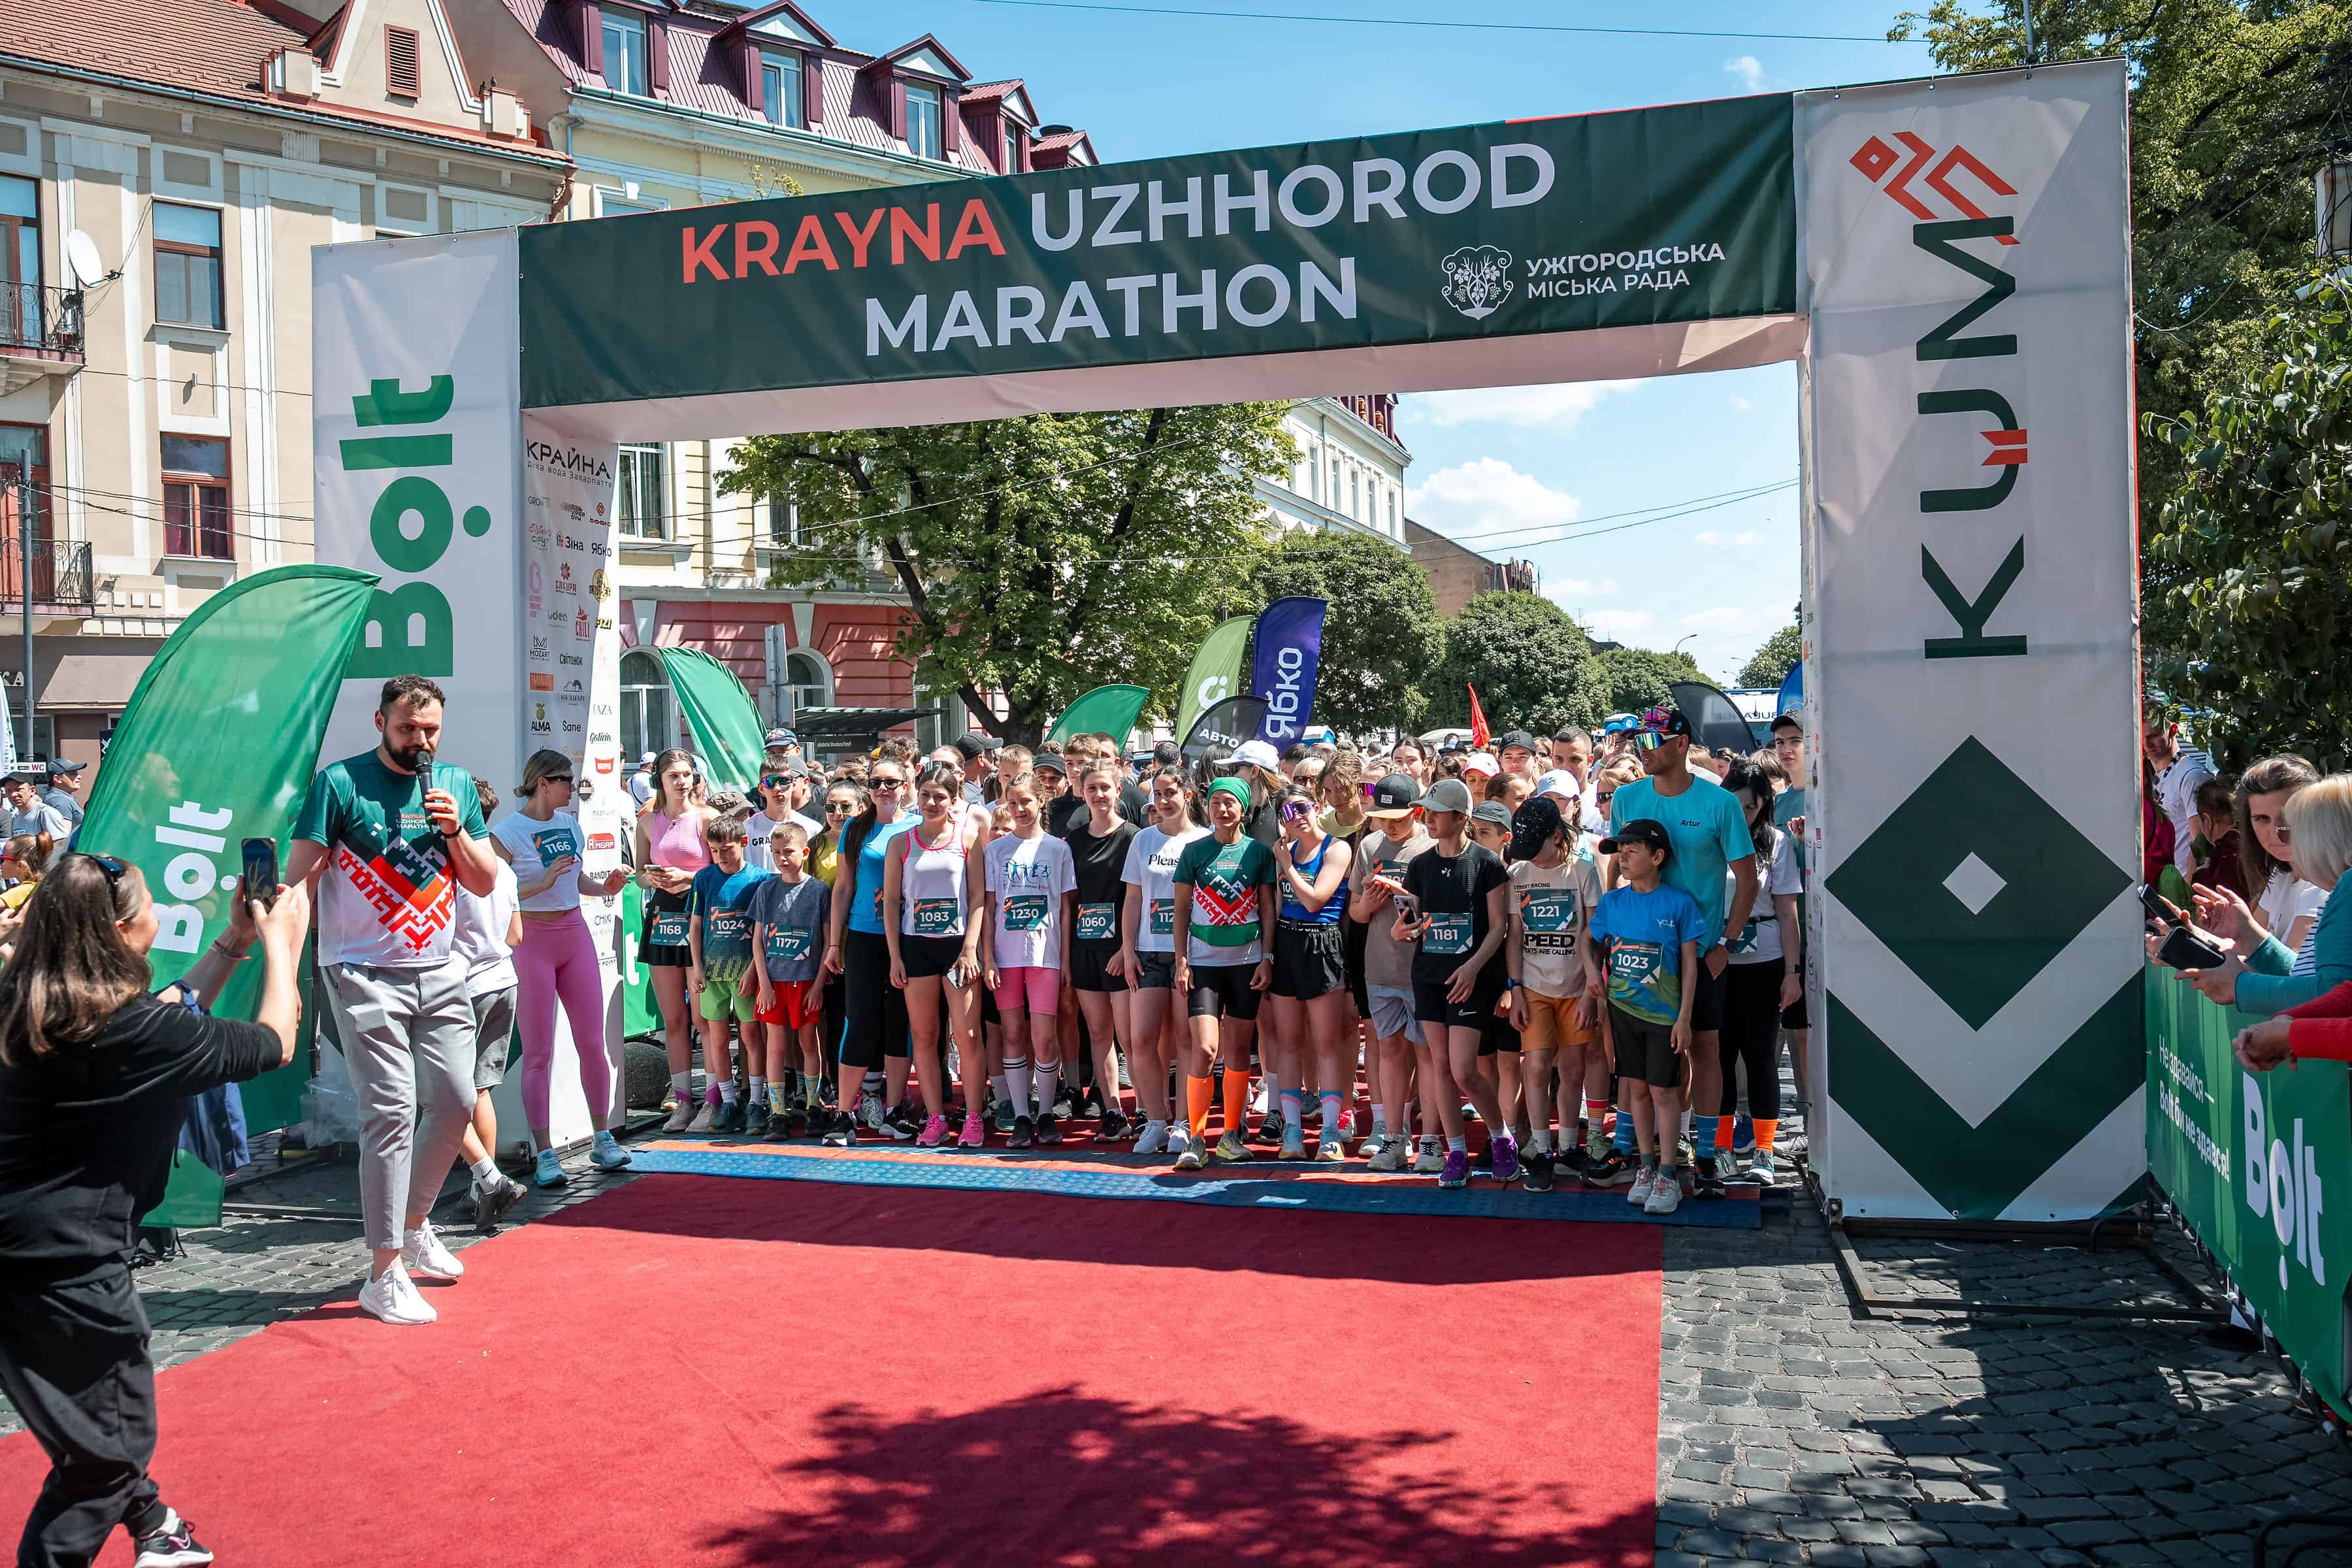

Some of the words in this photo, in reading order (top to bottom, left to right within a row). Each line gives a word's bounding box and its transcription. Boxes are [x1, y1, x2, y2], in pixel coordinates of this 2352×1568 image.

[683, 199, 1006, 284] KRAYNA
[1032, 143, 1555, 252] UZHHOROD
[1526, 243, 1725, 277] УЖГОРОДСЬКА
[1528, 276, 1618, 299] МІСЬКА
[1624, 269, 1690, 291] РАДА
[866, 257, 1357, 356] MARATHON
[1913, 216, 2028, 659] KUM
[527, 438, 611, 480] КРАЙНА
[548, 466, 566, 477] вода
[339, 375, 491, 678] Bolt
[565, 536, 584, 551] Зіна
[591, 542, 612, 557] Ябко
[575, 620, 590, 638] CHILI
[530, 649, 550, 659] MOZART
[1265, 646, 1303, 740] Ябко
[531, 721, 551, 732] ALMA
[563, 719, 581, 732] Sane
[589, 732, 613, 744] Galicia
[1200, 728, 1239, 749] АВТО
[544, 841, 571, 854] 1166
[752, 836, 772, 847] GRA
[1148, 854, 1180, 866] Pleas
[151, 800, 237, 954] Bolt
[920, 911, 949, 922] 1083
[1011, 908, 1039, 920] 1230
[1158, 913, 1175, 923] 112
[1531, 906, 1560, 917] 1221
[717, 920, 745, 930] 1024
[1081, 917, 1106, 927] 1060
[659, 924, 681, 935] 1168
[1432, 928, 1458, 941] 1181
[775, 937, 800, 949] 1177
[1524, 934, 1576, 948] PEED
[1618, 953, 1649, 969] 1023
[2159, 1034, 2168, 1069] Не
[2169, 1051, 2204, 1103] здавайся
[2160, 1079, 2174, 1123] Bolt
[2185, 1114, 2196, 1145] не
[2197, 1126, 2230, 1183] здався!
[2243, 1071, 2325, 1290] Bolt
